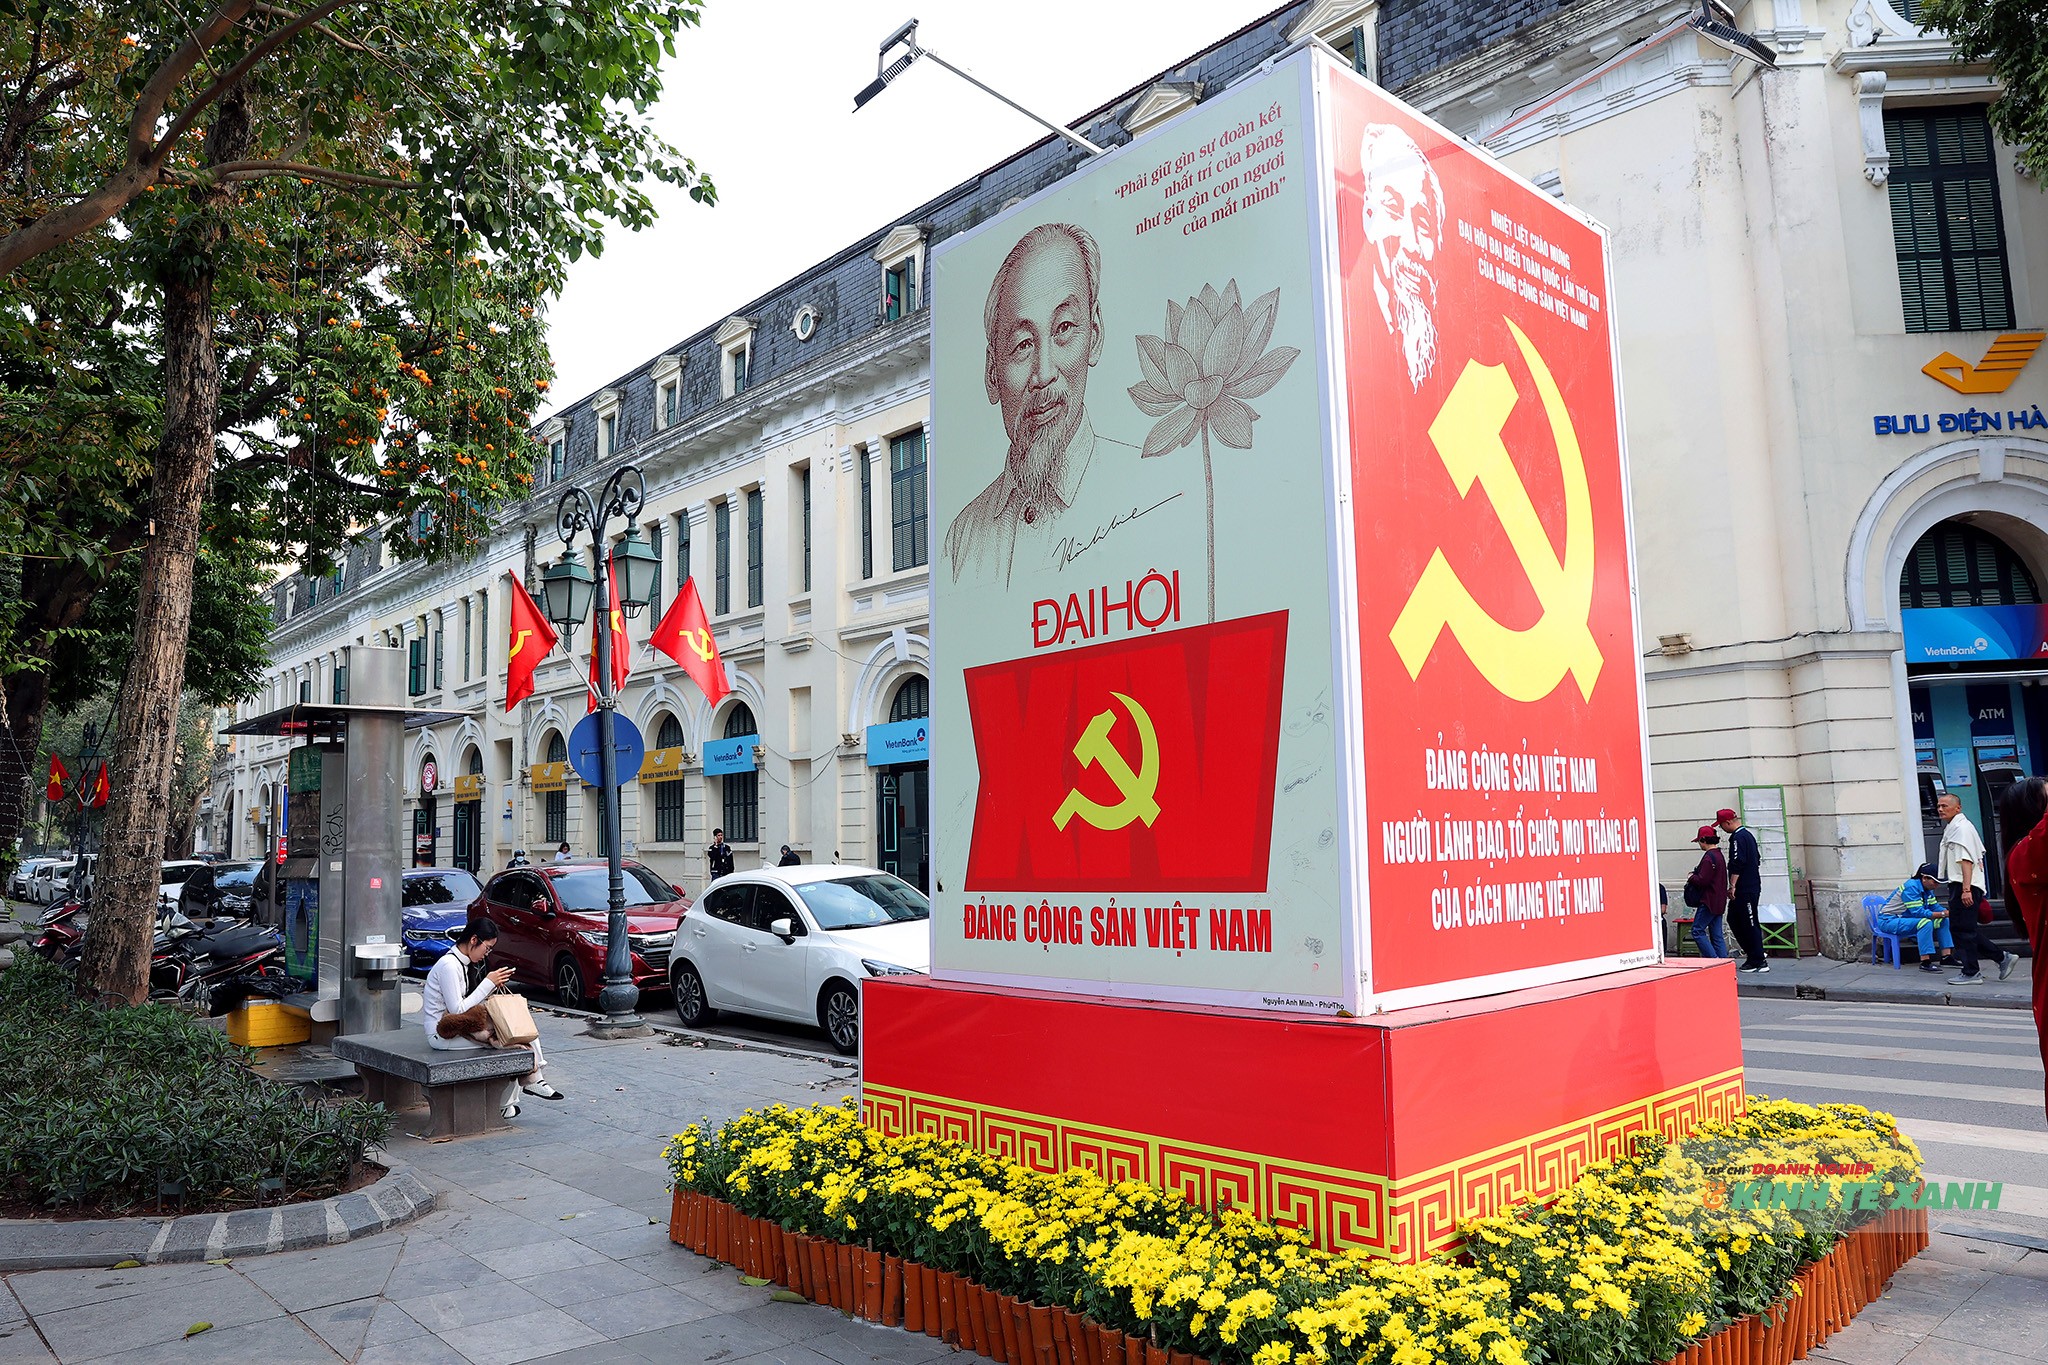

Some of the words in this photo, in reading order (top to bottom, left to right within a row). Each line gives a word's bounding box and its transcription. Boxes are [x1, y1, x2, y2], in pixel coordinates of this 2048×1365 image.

[1151, 159, 1172, 185] giữ
[1175, 151, 1196, 173] gìn
[1199, 138, 1216, 158] sự
[1219, 121, 1255, 148] đoàn
[1259, 101, 1282, 128] kết
[1164, 170, 1194, 199] nhất
[1197, 161, 1212, 183] trí
[1216, 151, 1242, 172] của
[1245, 128, 1284, 159] Đảng
[1135, 211, 1161, 236] như
[1163, 198, 1186, 225] giữ
[1188, 189, 1210, 213] gìn
[1213, 176, 1239, 198] con
[1182, 214, 1208, 236] của
[1211, 197, 1238, 224] mắt
[1490, 208, 1513, 238] NHIỆT
[1513, 223, 1529, 248] LIỆT
[1530, 232, 1549, 258] CHÀO
[1474, 227, 1488, 252] HỘI
[1503, 242, 1521, 269] BIỂU
[1522, 255, 1541, 280] TOÀN
[1478, 253, 1495, 282] CỦA
[1518, 278, 1538, 305] CỘNG
[1539, 285, 1554, 313] SẢN
[1554, 298, 1569, 323] VIỆT
[1874, 413, 1930, 436] BƯU
[1937, 407, 2002, 434] ĐIỆN
[2007, 404, 2048, 430] HÀ
[1031, 589, 1095, 648] ĐẠI
[1102, 568, 1181, 635] HỘI
[1924, 645, 1976, 656] VietinBank
[885, 737, 918, 749] VietinBank
[1978, 708, 2005, 719] ATM
[1425, 731, 1469, 791] ĐẢNG
[1471, 743, 1510, 800] CỘNG
[1512, 738, 1540, 792] SẢN
[1541, 748, 1567, 801] VIỆT
[1569, 756, 1598, 793] NAM
[1382, 809, 1432, 865] NGƯỜI
[1435, 812, 1474, 861] LÃNH
[1476, 820, 1509, 868] ĐẠO,
[1508, 804, 1525, 858] TỔ
[1527, 808, 1560, 857] CHỨC
[1561, 819, 1585, 864] MỌI
[1586, 807, 1622, 854] THẮNG
[1623, 816, 1640, 861] LỢI
[963, 896, 1017, 942] ĐẢNG
[1023, 899, 1083, 950] CỘNG
[1090, 897, 1137, 947] SẢN
[1144, 901, 1201, 957] VIỆT
[1210, 908, 1272, 953] NAM
[1431, 869, 1462, 931] CỦA
[1464, 876, 1503, 927] CÁCH
[1505, 880, 1544, 930] MẠNG
[1545, 871, 1571, 925] VIỆT
[1573, 876, 1605, 915] NAM!
[1286, 998, 1298, 1006] Anh
